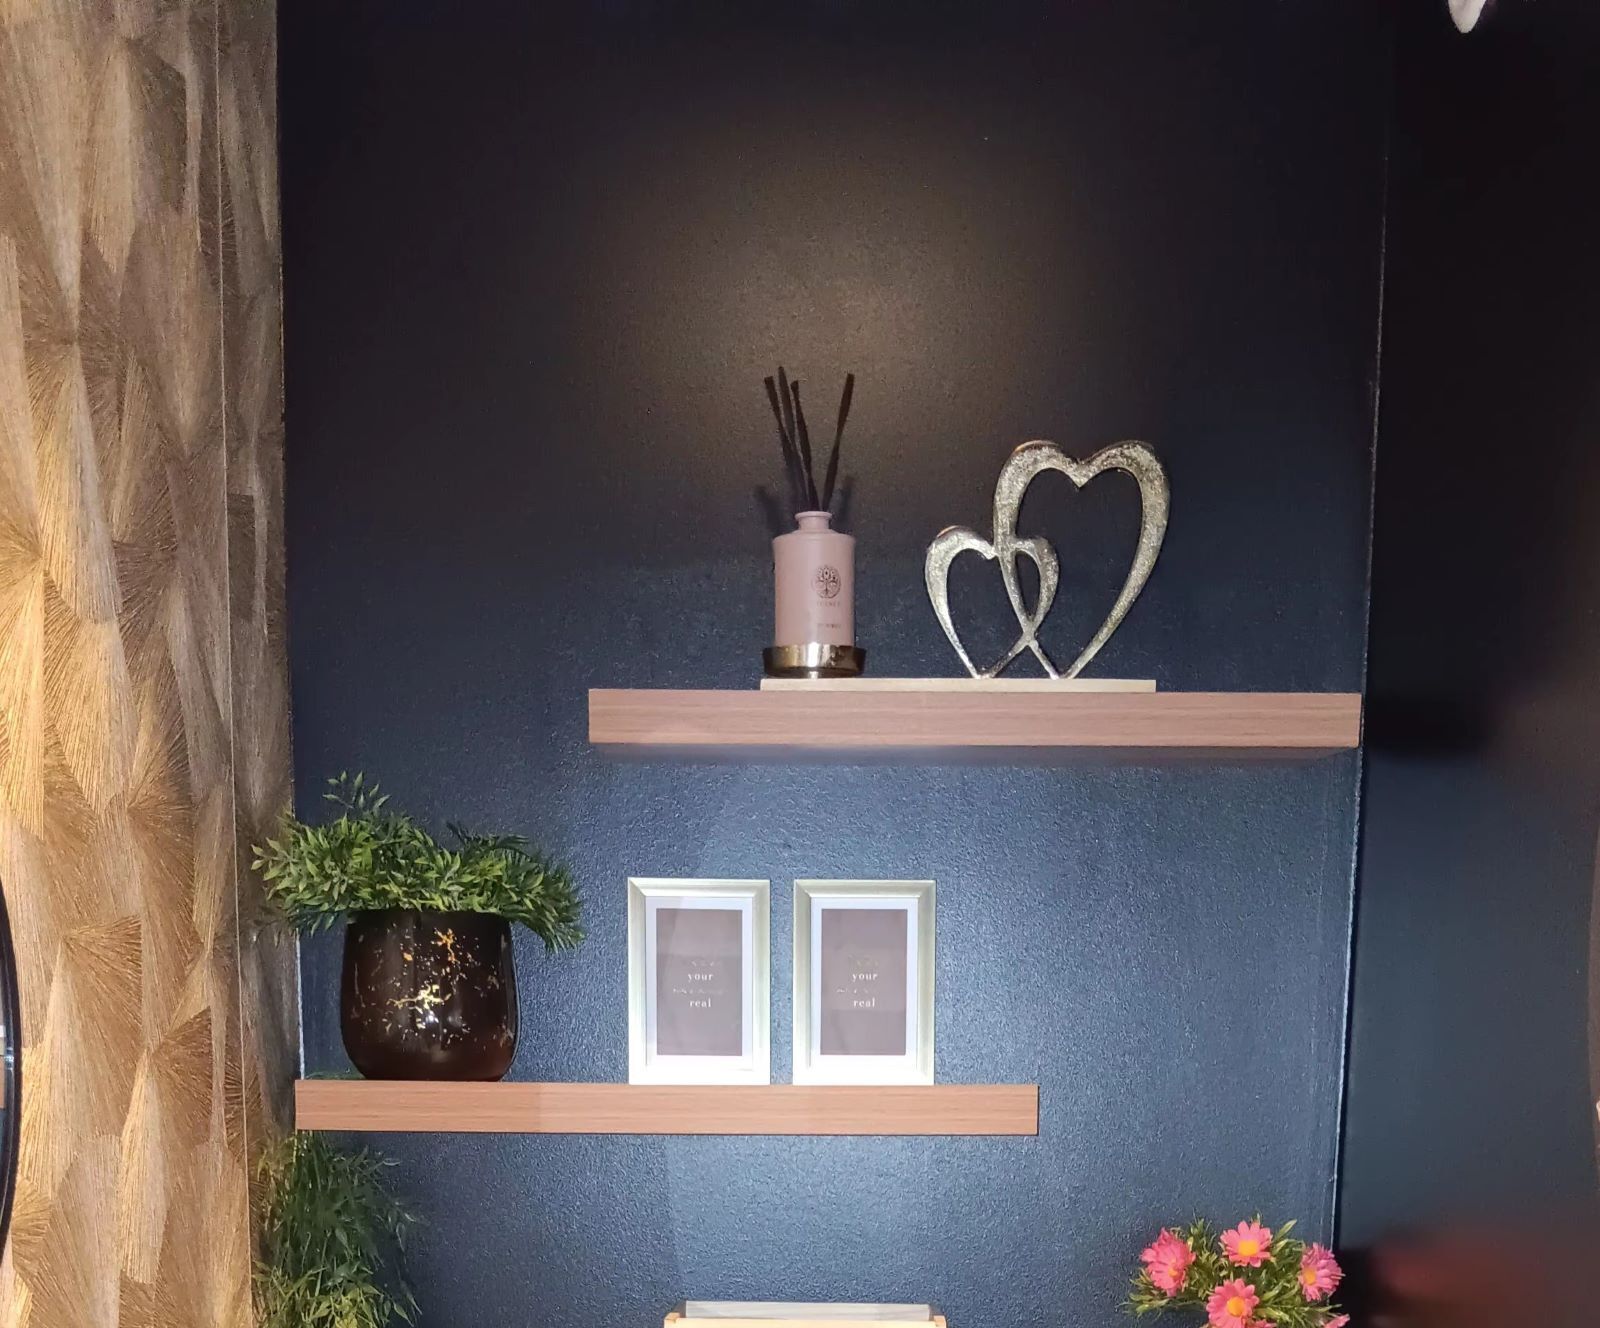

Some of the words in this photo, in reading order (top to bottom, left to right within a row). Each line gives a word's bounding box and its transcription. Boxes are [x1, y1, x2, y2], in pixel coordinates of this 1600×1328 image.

[687, 973, 714, 983] your
[852, 973, 878, 983] your
[689, 997, 711, 1008] real
[853, 997, 875, 1008] real
